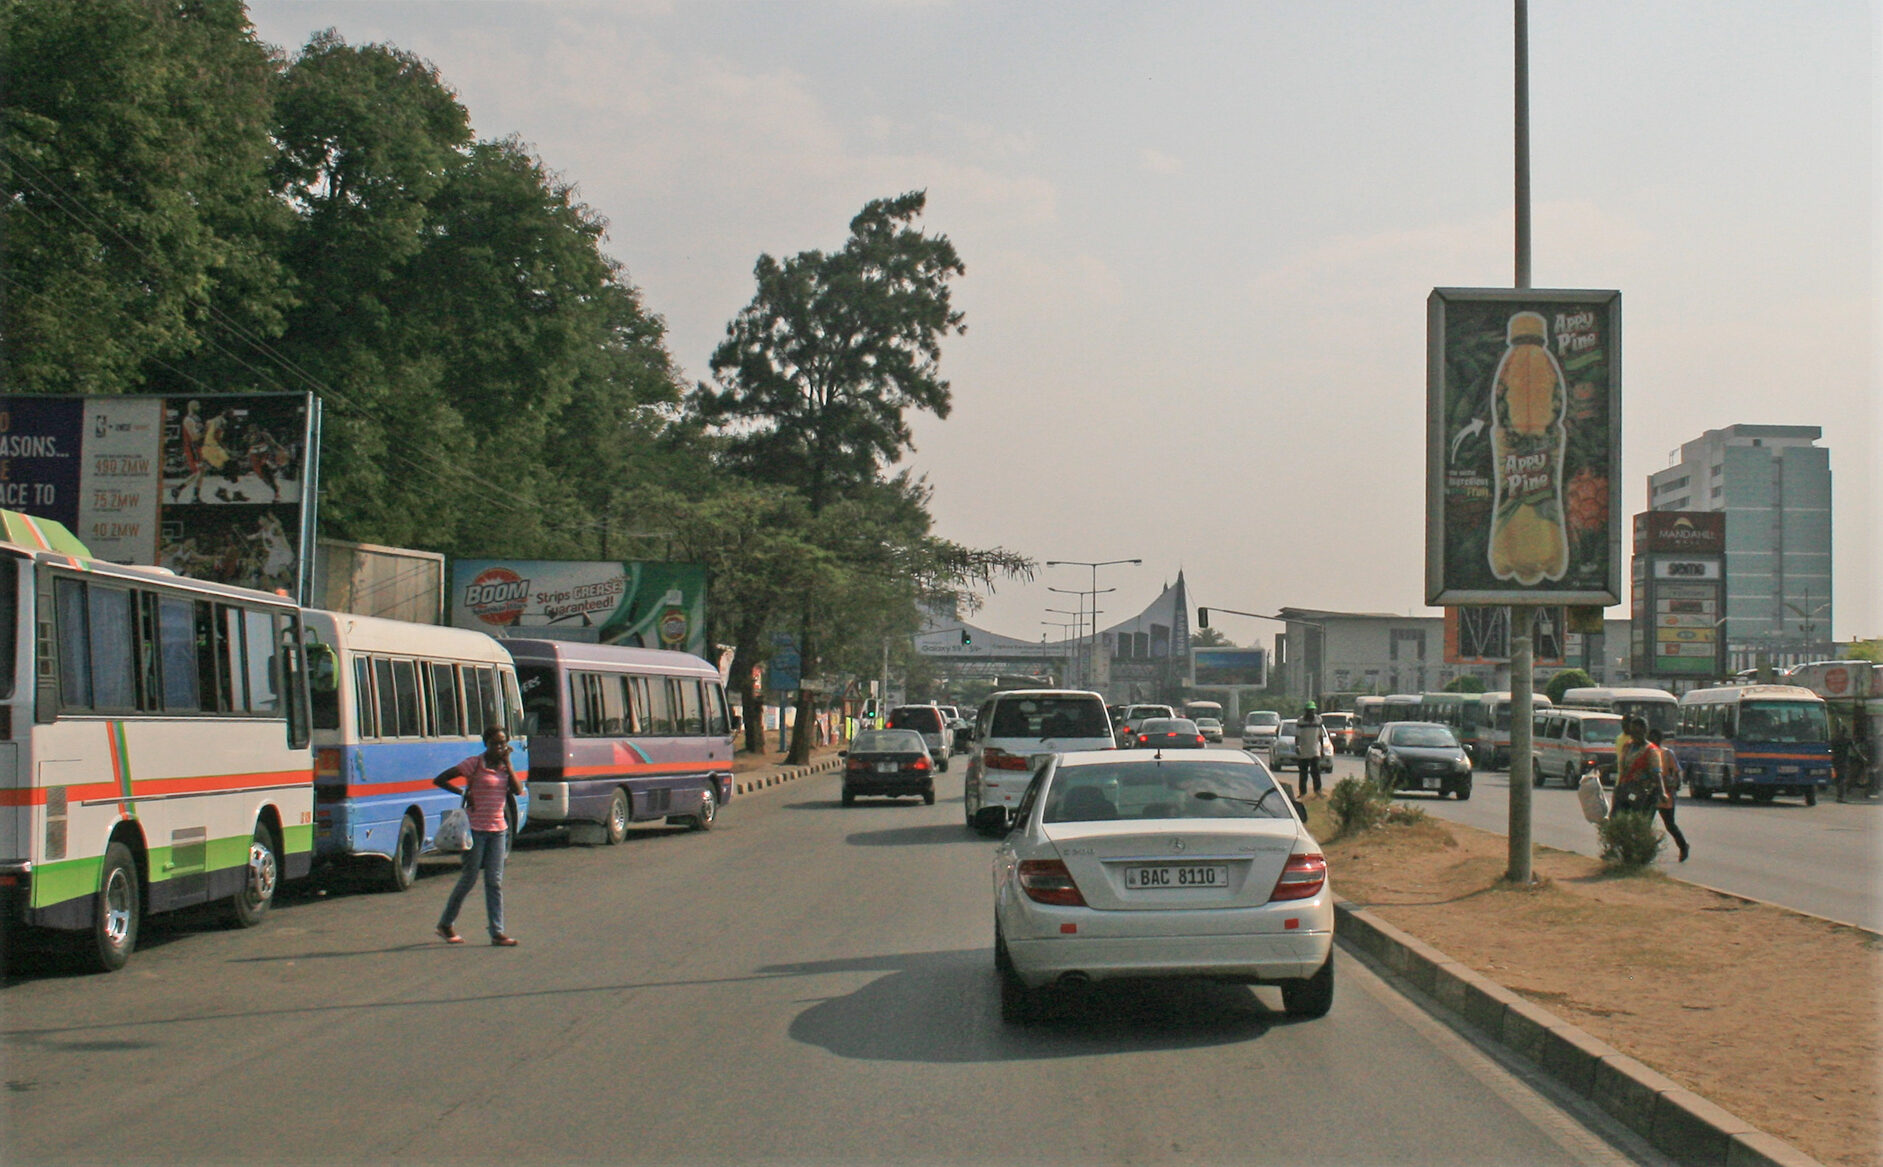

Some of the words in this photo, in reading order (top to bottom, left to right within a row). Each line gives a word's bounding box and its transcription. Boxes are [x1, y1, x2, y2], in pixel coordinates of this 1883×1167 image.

[34, 483, 55, 505] TO
[111, 493, 140, 508] ZMW
[111, 522, 140, 537] ZMW
[464, 579, 530, 607] BOOM
[536, 589, 571, 604] Strips
[544, 595, 615, 617] Guaranteed!
[1140, 869, 1170, 885] BAC
[1178, 868, 1215, 884] 8110
